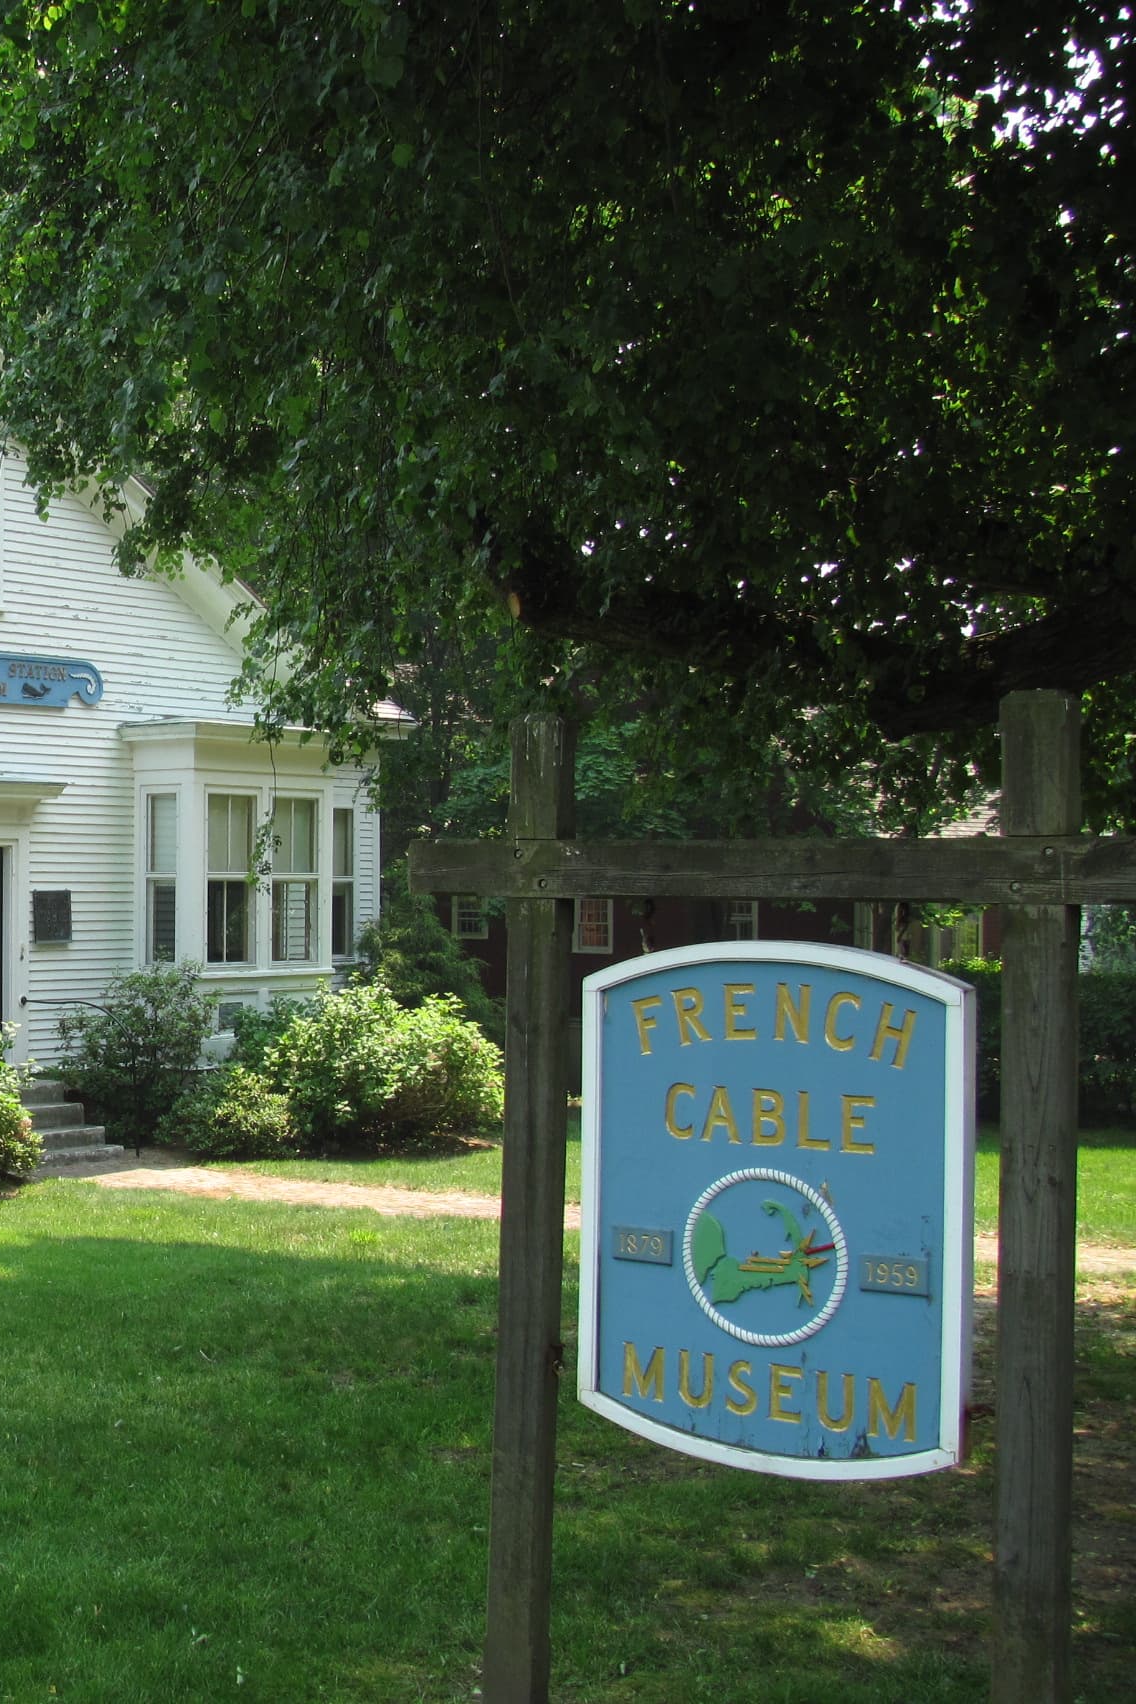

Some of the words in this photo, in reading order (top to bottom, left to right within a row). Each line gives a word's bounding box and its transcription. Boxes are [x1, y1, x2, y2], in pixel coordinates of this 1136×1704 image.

[8, 662, 67, 681] STATION
[631, 982, 917, 1069] FRENCH
[665, 1082, 875, 1155] CABLE
[618, 1232, 663, 1256] 1879
[864, 1261, 918, 1287] 1959
[622, 1341, 917, 1442] MUSEUM
